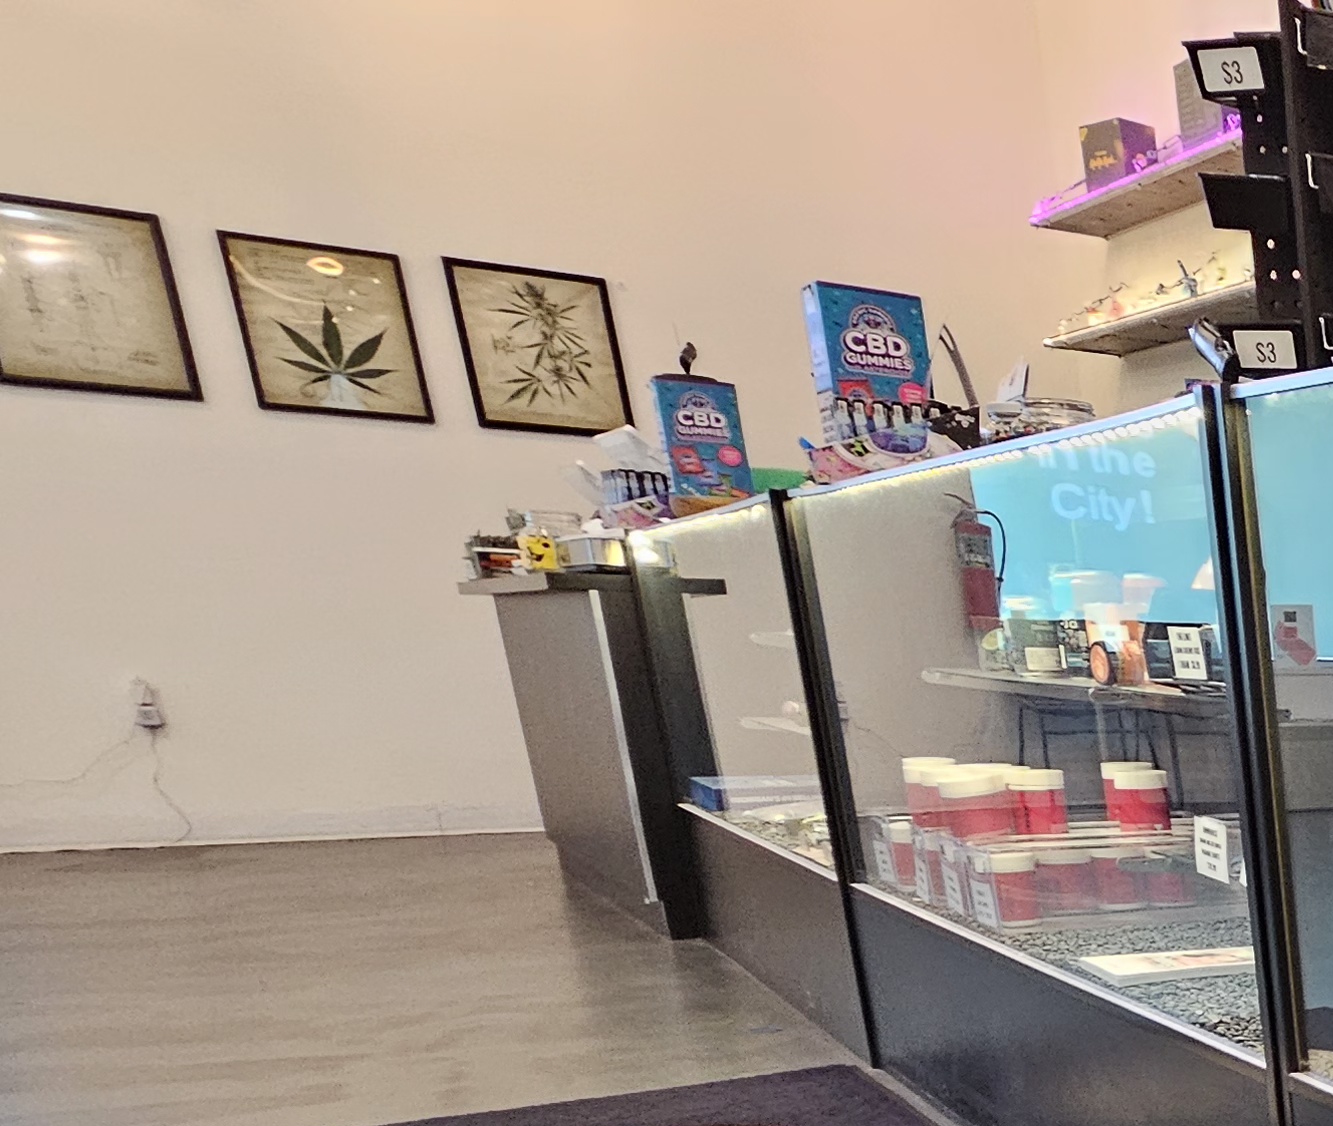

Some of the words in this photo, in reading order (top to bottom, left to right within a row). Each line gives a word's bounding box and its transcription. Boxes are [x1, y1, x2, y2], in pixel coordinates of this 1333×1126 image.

[1220, 60, 1244, 85] S3
[844, 330, 908, 357] CBD
[1256, 342, 1277, 363] S3
[845, 352, 913, 370] GUMMIES
[677, 410, 725, 427] CBD
[1087, 444, 1156, 478] the
[1050, 483, 1155, 532] City!
